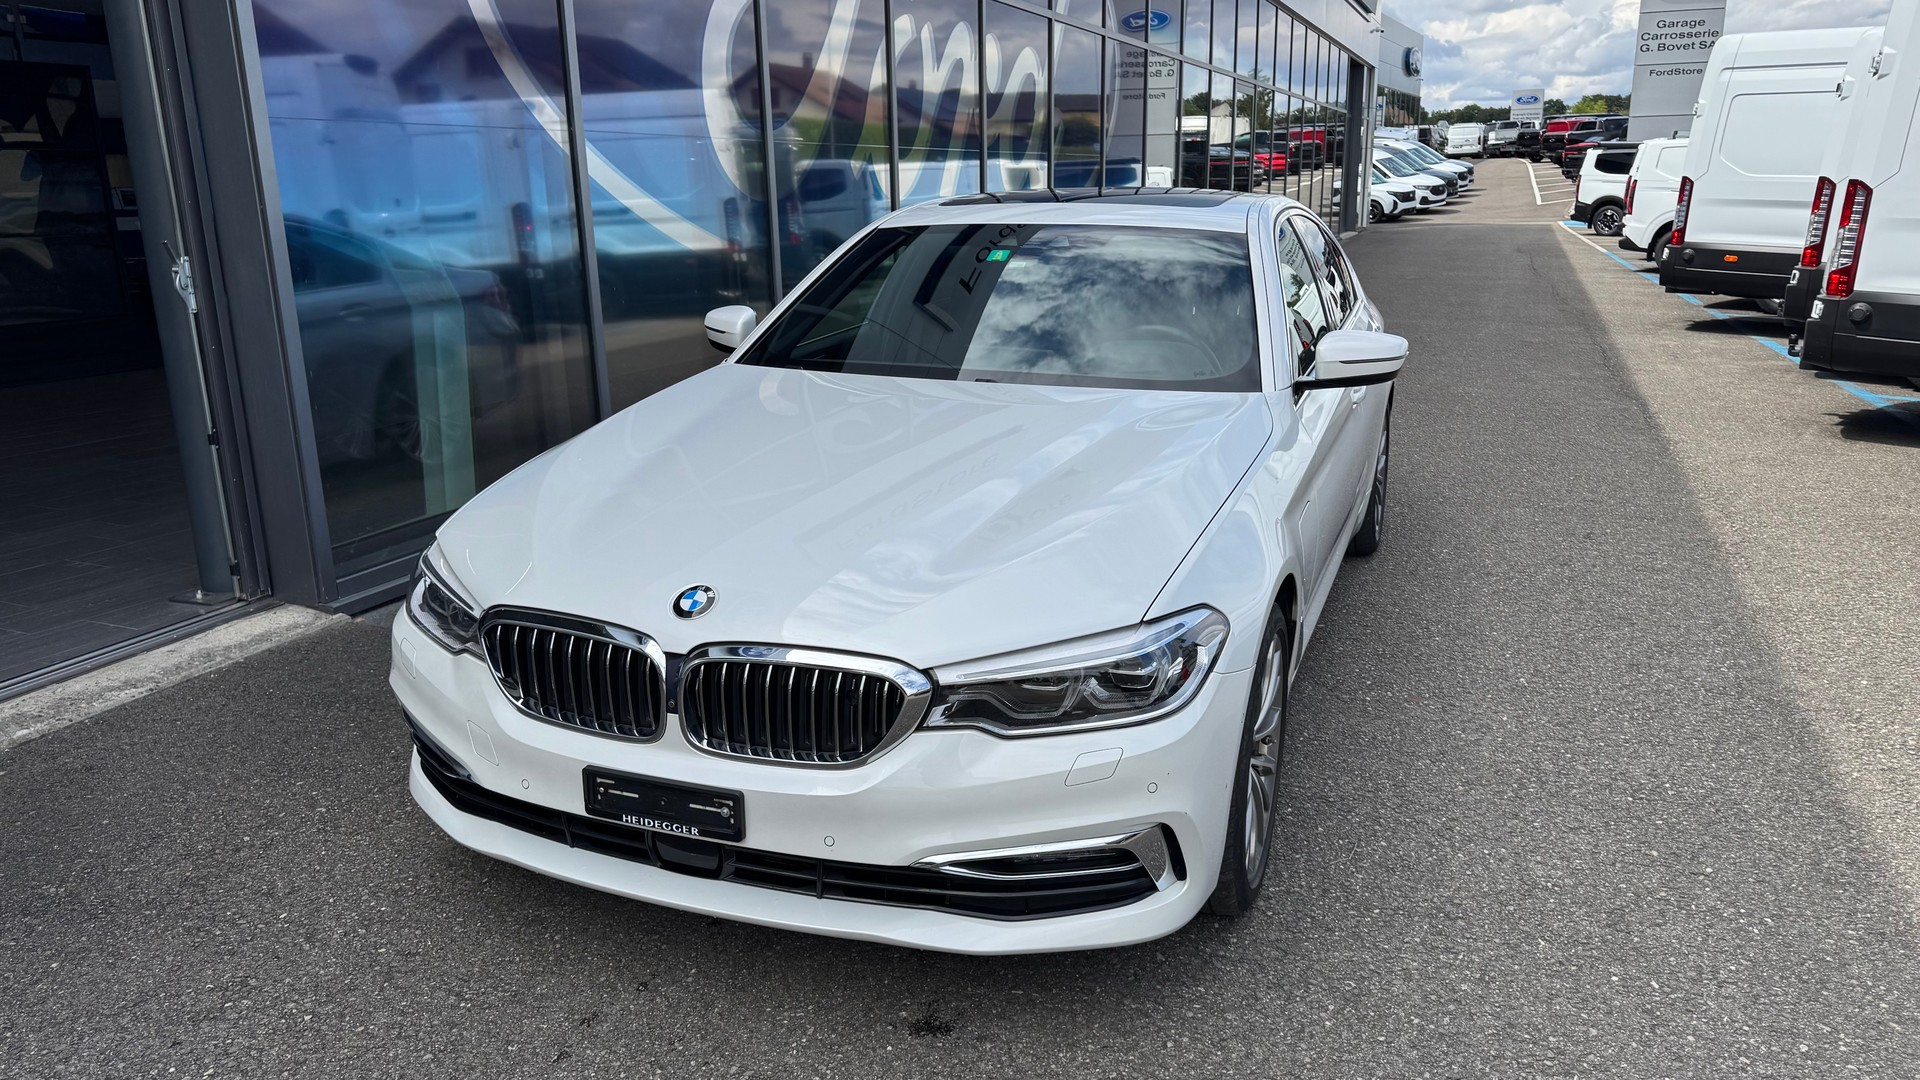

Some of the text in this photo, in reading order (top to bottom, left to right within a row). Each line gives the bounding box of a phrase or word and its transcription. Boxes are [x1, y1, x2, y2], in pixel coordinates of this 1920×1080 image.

[1656, 19, 1706, 29] Garage
[1640, 29, 1719, 41] Carrosserie
[1640, 40, 1716, 53] G. Bovet SA
[1649, 67, 1703, 77] FordStore
[622, 814, 699, 836] HEIDEGGER
